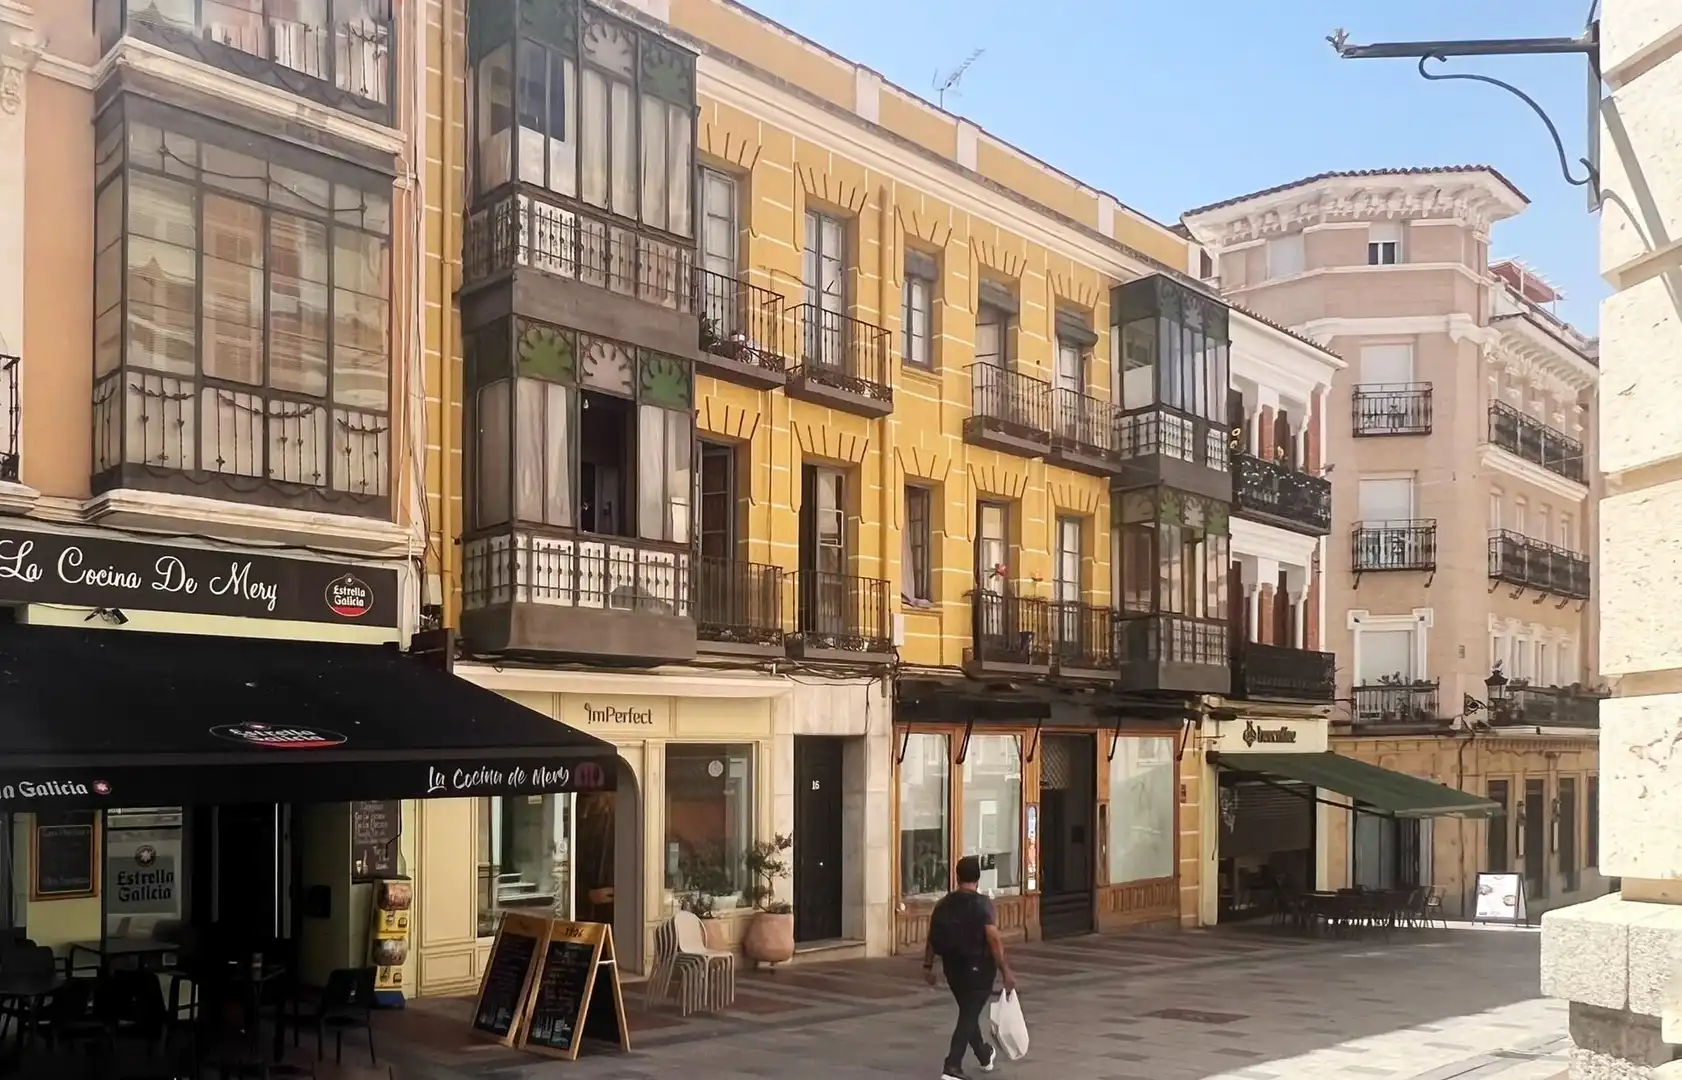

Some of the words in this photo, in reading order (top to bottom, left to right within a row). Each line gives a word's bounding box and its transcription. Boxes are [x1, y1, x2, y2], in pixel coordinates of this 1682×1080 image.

[0, 540, 43, 582] La
[57, 546, 142, 588] Cocina
[151, 555, 198, 594] De
[209, 561, 278, 611] Mery
[332, 584, 366, 597] Estrella
[334, 594, 364, 607] Galicia
[427, 766, 447, 793] La
[453, 766, 503, 789] Cocina
[507, 766, 528, 788] de
[532, 766, 570, 788] Mery
[18, 780, 89, 798] Galicia
[117, 868, 174, 886] Estrella
[118, 884, 172, 902] Galicia
